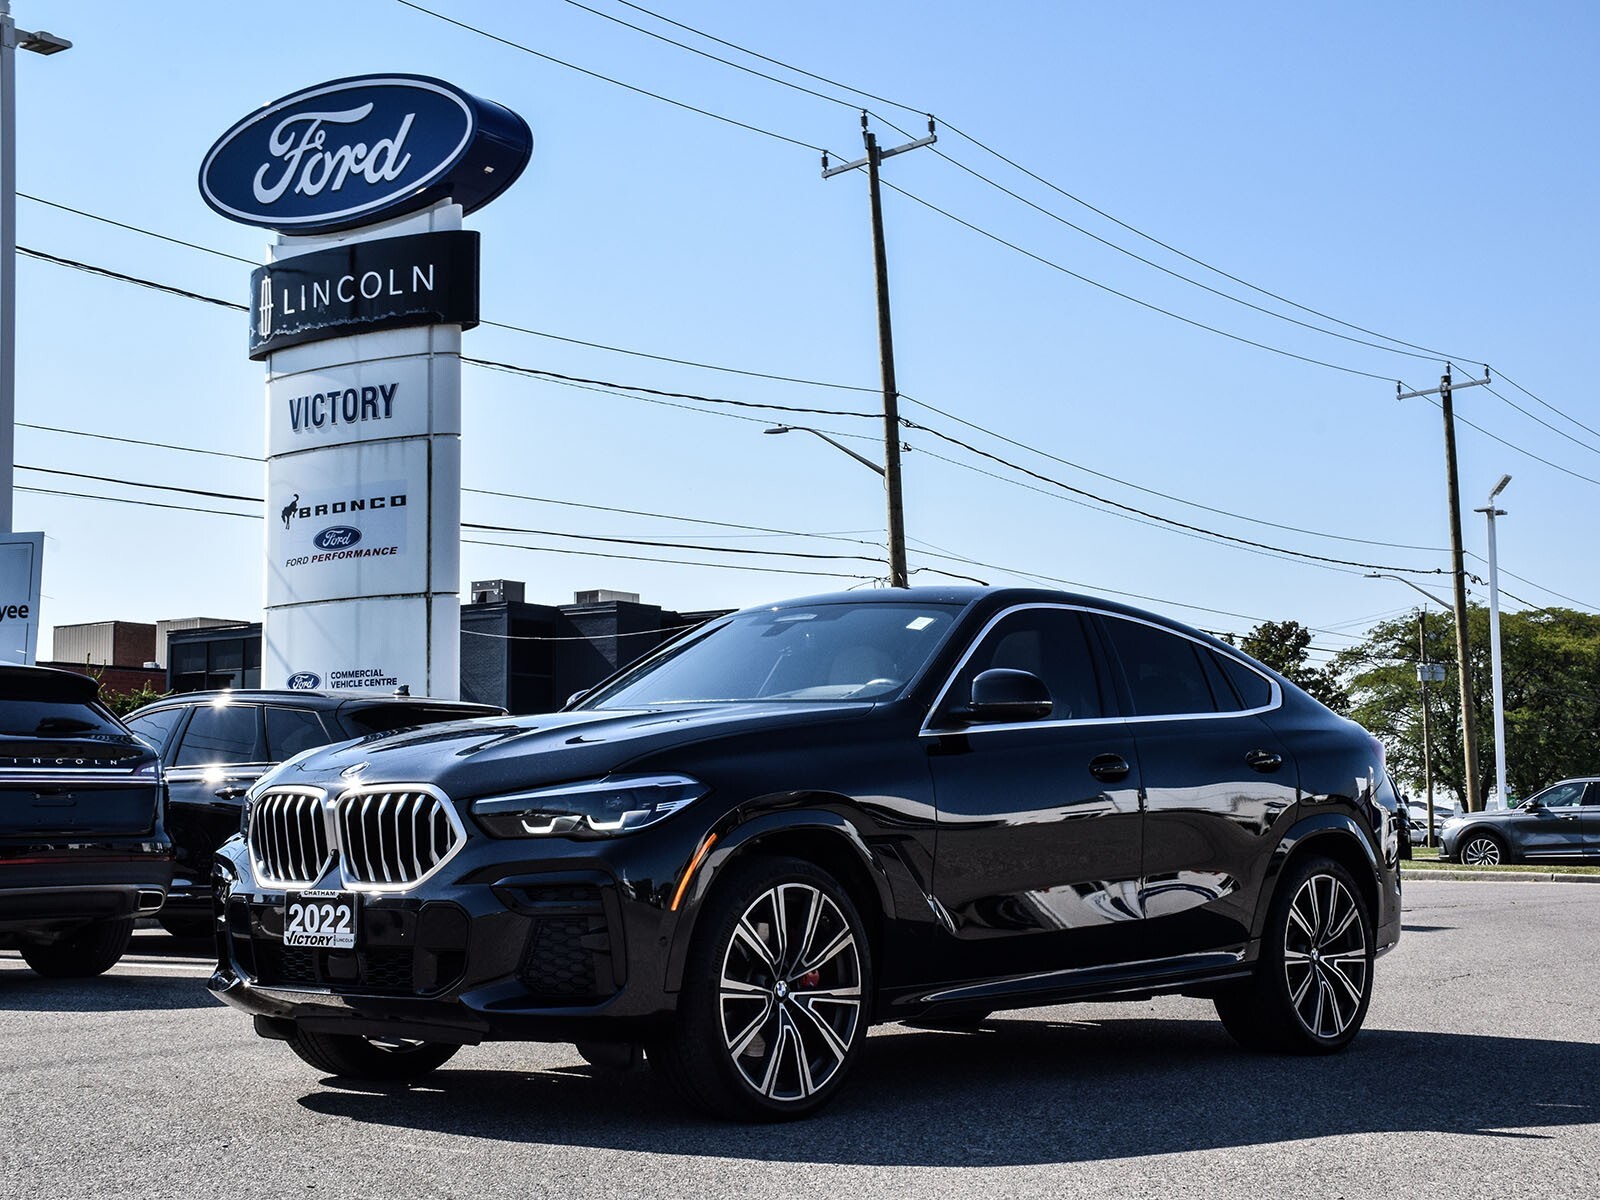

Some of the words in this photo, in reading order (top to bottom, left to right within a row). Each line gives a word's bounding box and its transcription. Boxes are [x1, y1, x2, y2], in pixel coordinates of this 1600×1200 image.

[253, 102, 416, 204] Ford
[283, 264, 435, 315] LINCOLN
[289, 382, 400, 432] VICTORY
[299, 495, 406, 518] BRONCO
[323, 530, 351, 547] Ford
[285, 556, 309, 568] FORD
[311, 547, 398, 562] PERFORMANCE
[293, 675, 314, 689] Ford
[330, 669, 383, 679] COMMERCIAL
[330, 679, 363, 689] VEHICLE
[364, 677, 398, 687] CENTRE
[289, 903, 351, 933] 2022
[286, 931, 333, 945] VICTORY
